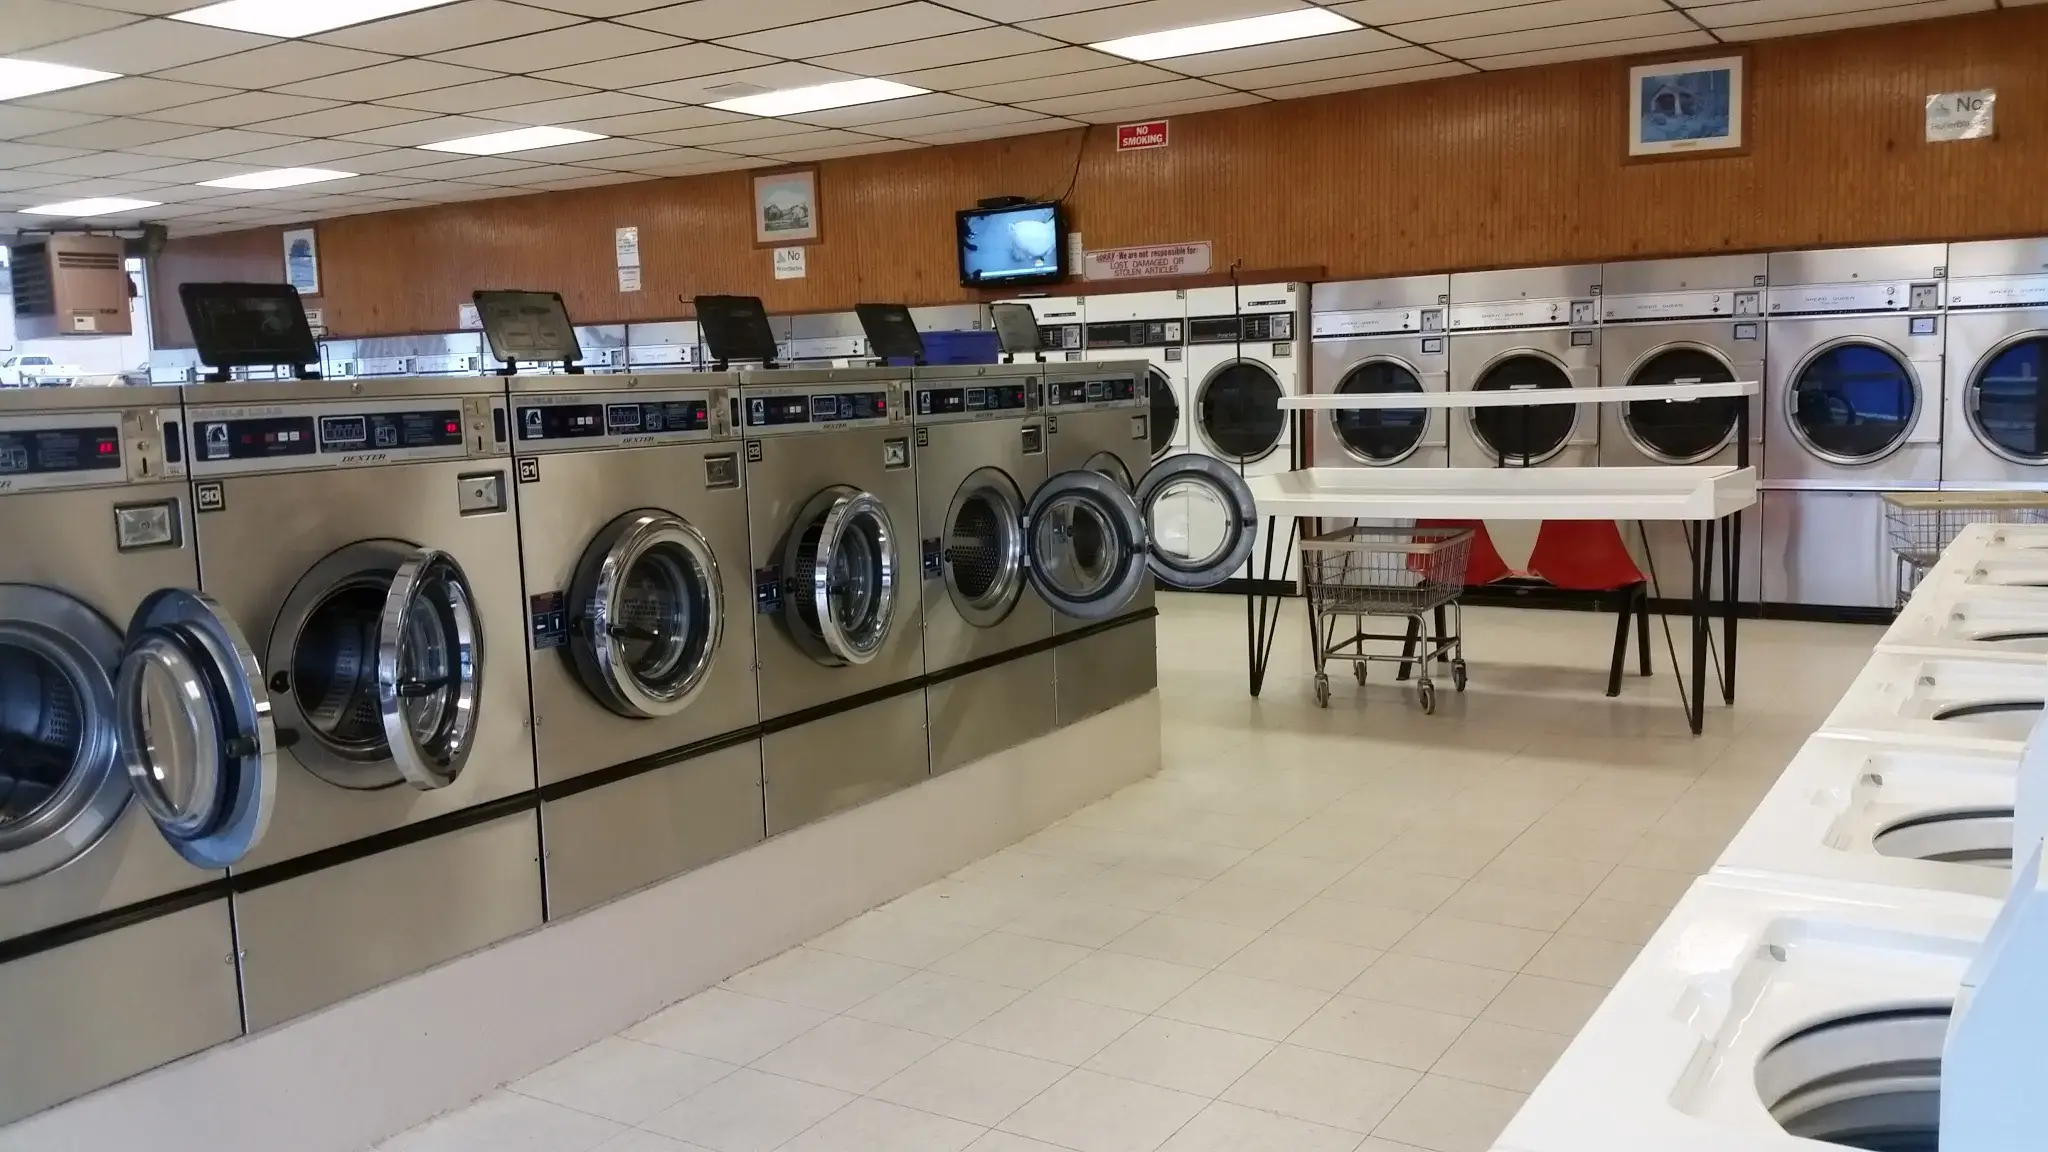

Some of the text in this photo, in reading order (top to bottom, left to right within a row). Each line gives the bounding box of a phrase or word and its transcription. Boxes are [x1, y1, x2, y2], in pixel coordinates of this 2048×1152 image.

[1956, 97, 1984, 112] No
[1136, 126, 1149, 135] NO
[1122, 133, 1163, 147] SMOKING
[787, 250, 800, 261] No
[1139, 250, 1149, 258] not
[1151, 247, 1186, 257] responsible
[1132, 258, 1169, 267] DAMAGED
[1172, 256, 1185, 265] OR
[1114, 264, 1179, 277] STOLEN ARTICLES
[622, 436, 655, 444] DEXTER
[749, 447, 760, 456] 32
[341, 453, 387, 463] DEXTER
[521, 464, 537, 476] 31
[201, 490, 219, 503] 30
